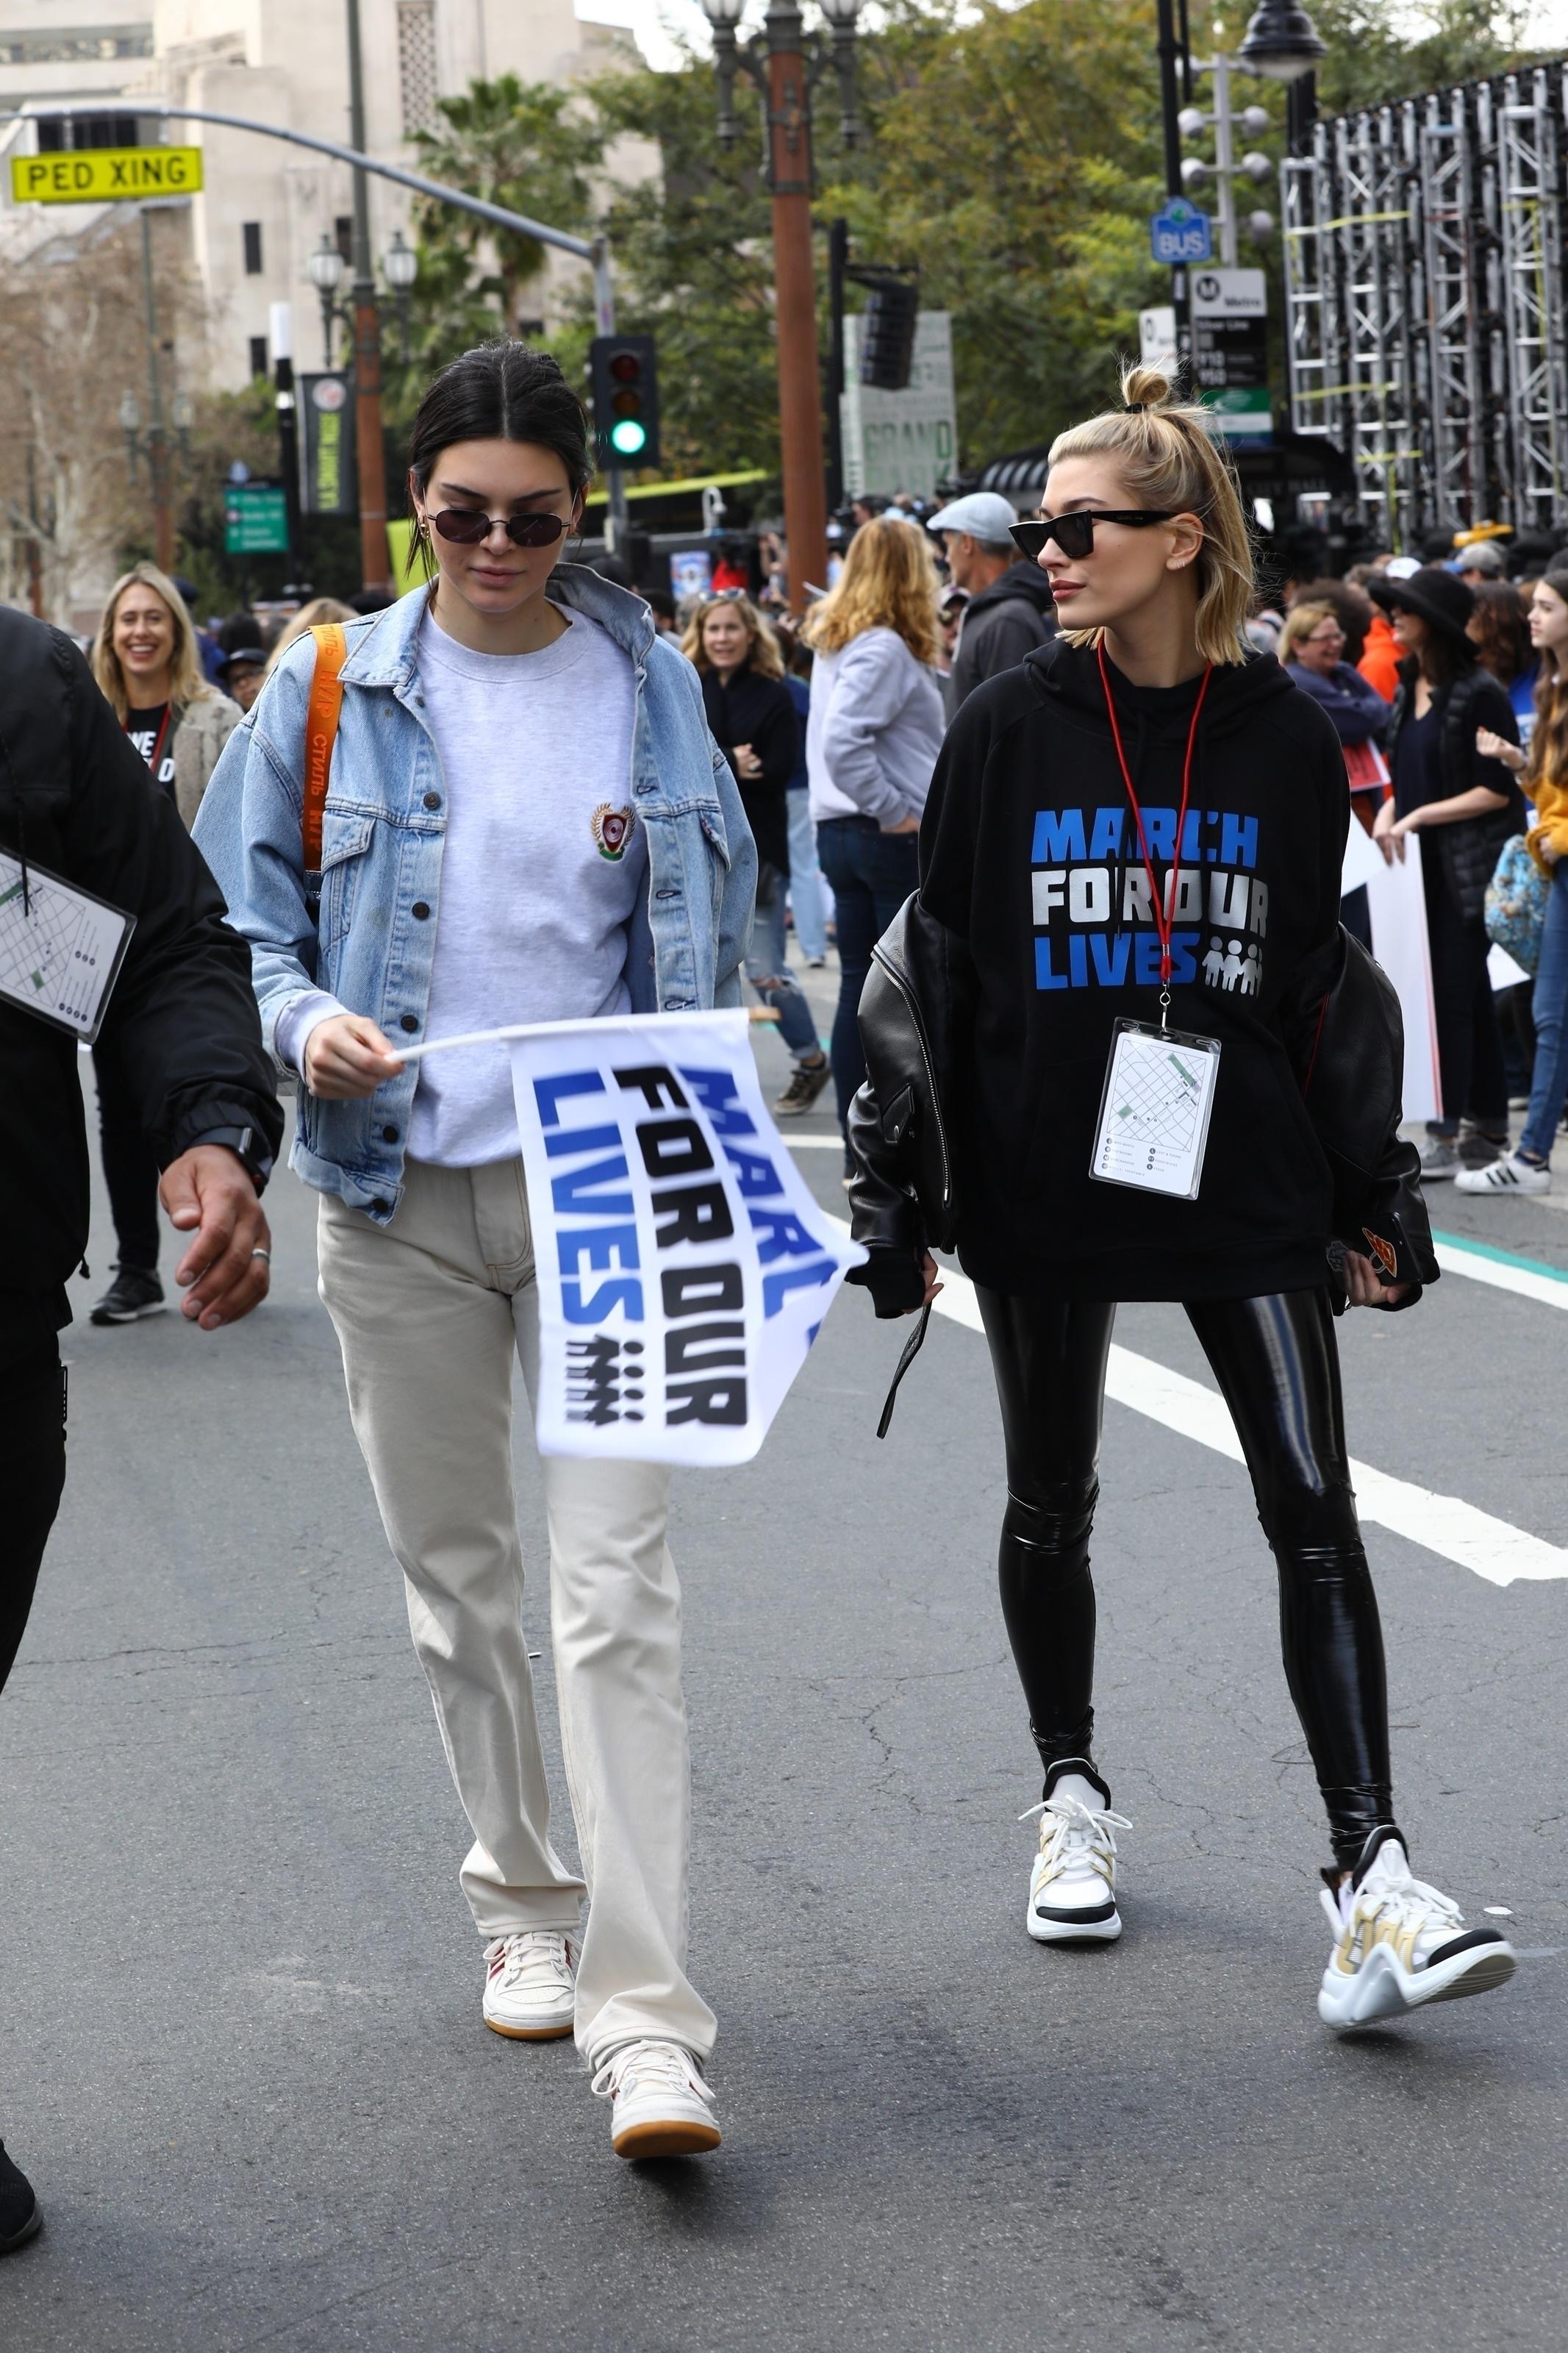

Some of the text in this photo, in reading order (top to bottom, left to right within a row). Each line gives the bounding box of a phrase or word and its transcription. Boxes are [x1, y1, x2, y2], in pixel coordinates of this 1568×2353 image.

[28, 156, 186, 192] PED XING
[1159, 232, 1203, 255] BUS
[1224, 298, 1261, 307] Metro
[864, 421, 952, 460] GRAND
[1031, 808, 1259, 868] MARCH
[1031, 867, 1268, 939] FOR OUR
[1035, 932, 1200, 990] LIVES
[532, 1070, 644, 1325] LIVES
[610, 1065, 747, 1427] FOR OUR
